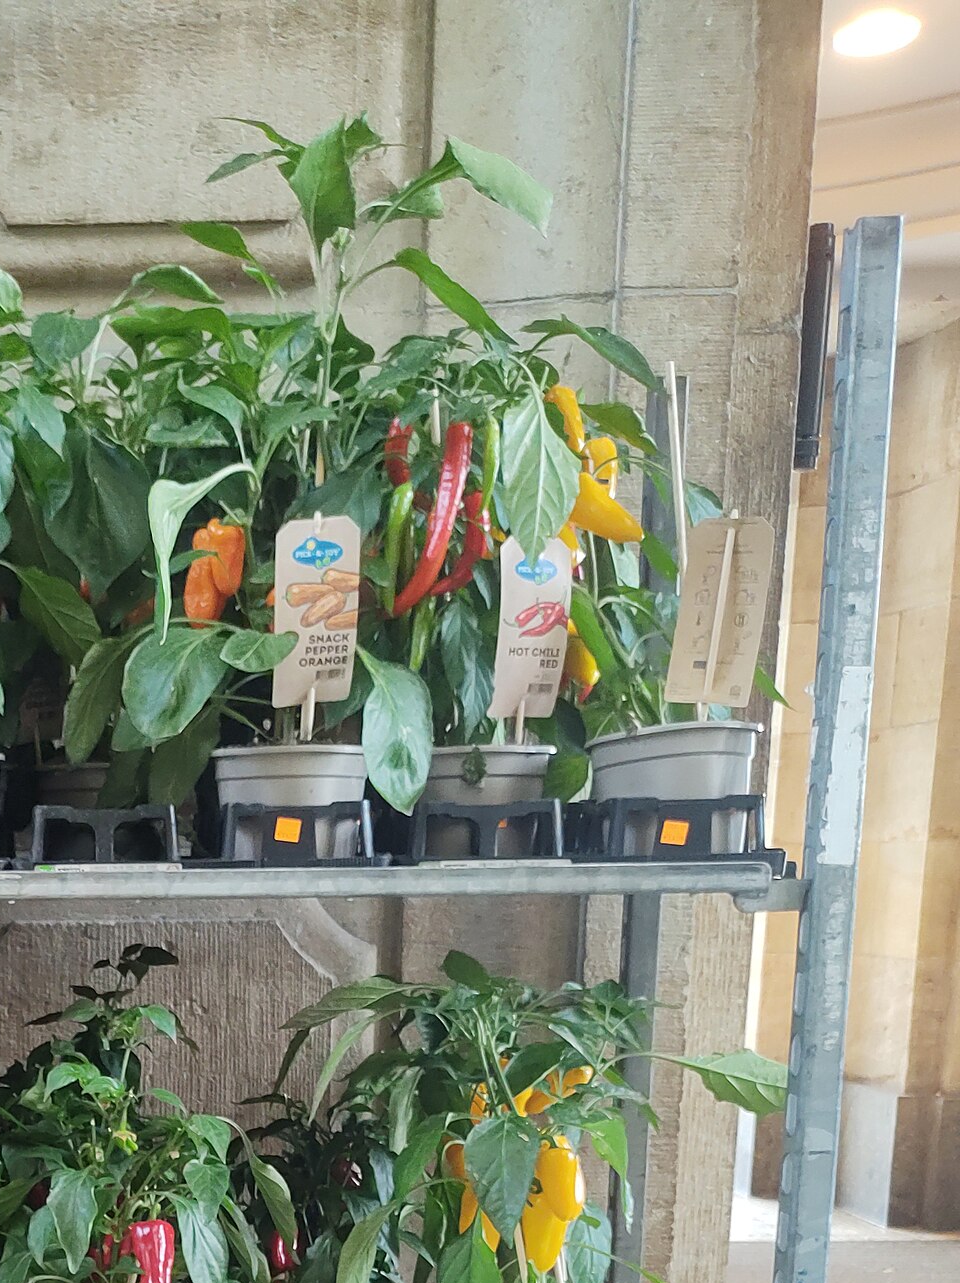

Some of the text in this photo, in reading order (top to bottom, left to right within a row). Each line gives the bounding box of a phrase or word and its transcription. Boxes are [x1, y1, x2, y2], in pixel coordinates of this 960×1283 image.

[308, 633, 350, 645] SNACK
[305, 644, 349, 656] PEPPER
[508, 647, 560, 658] HOT CHILI
[298, 655, 348, 668] ORANGE
[539, 659, 559, 669] RED
